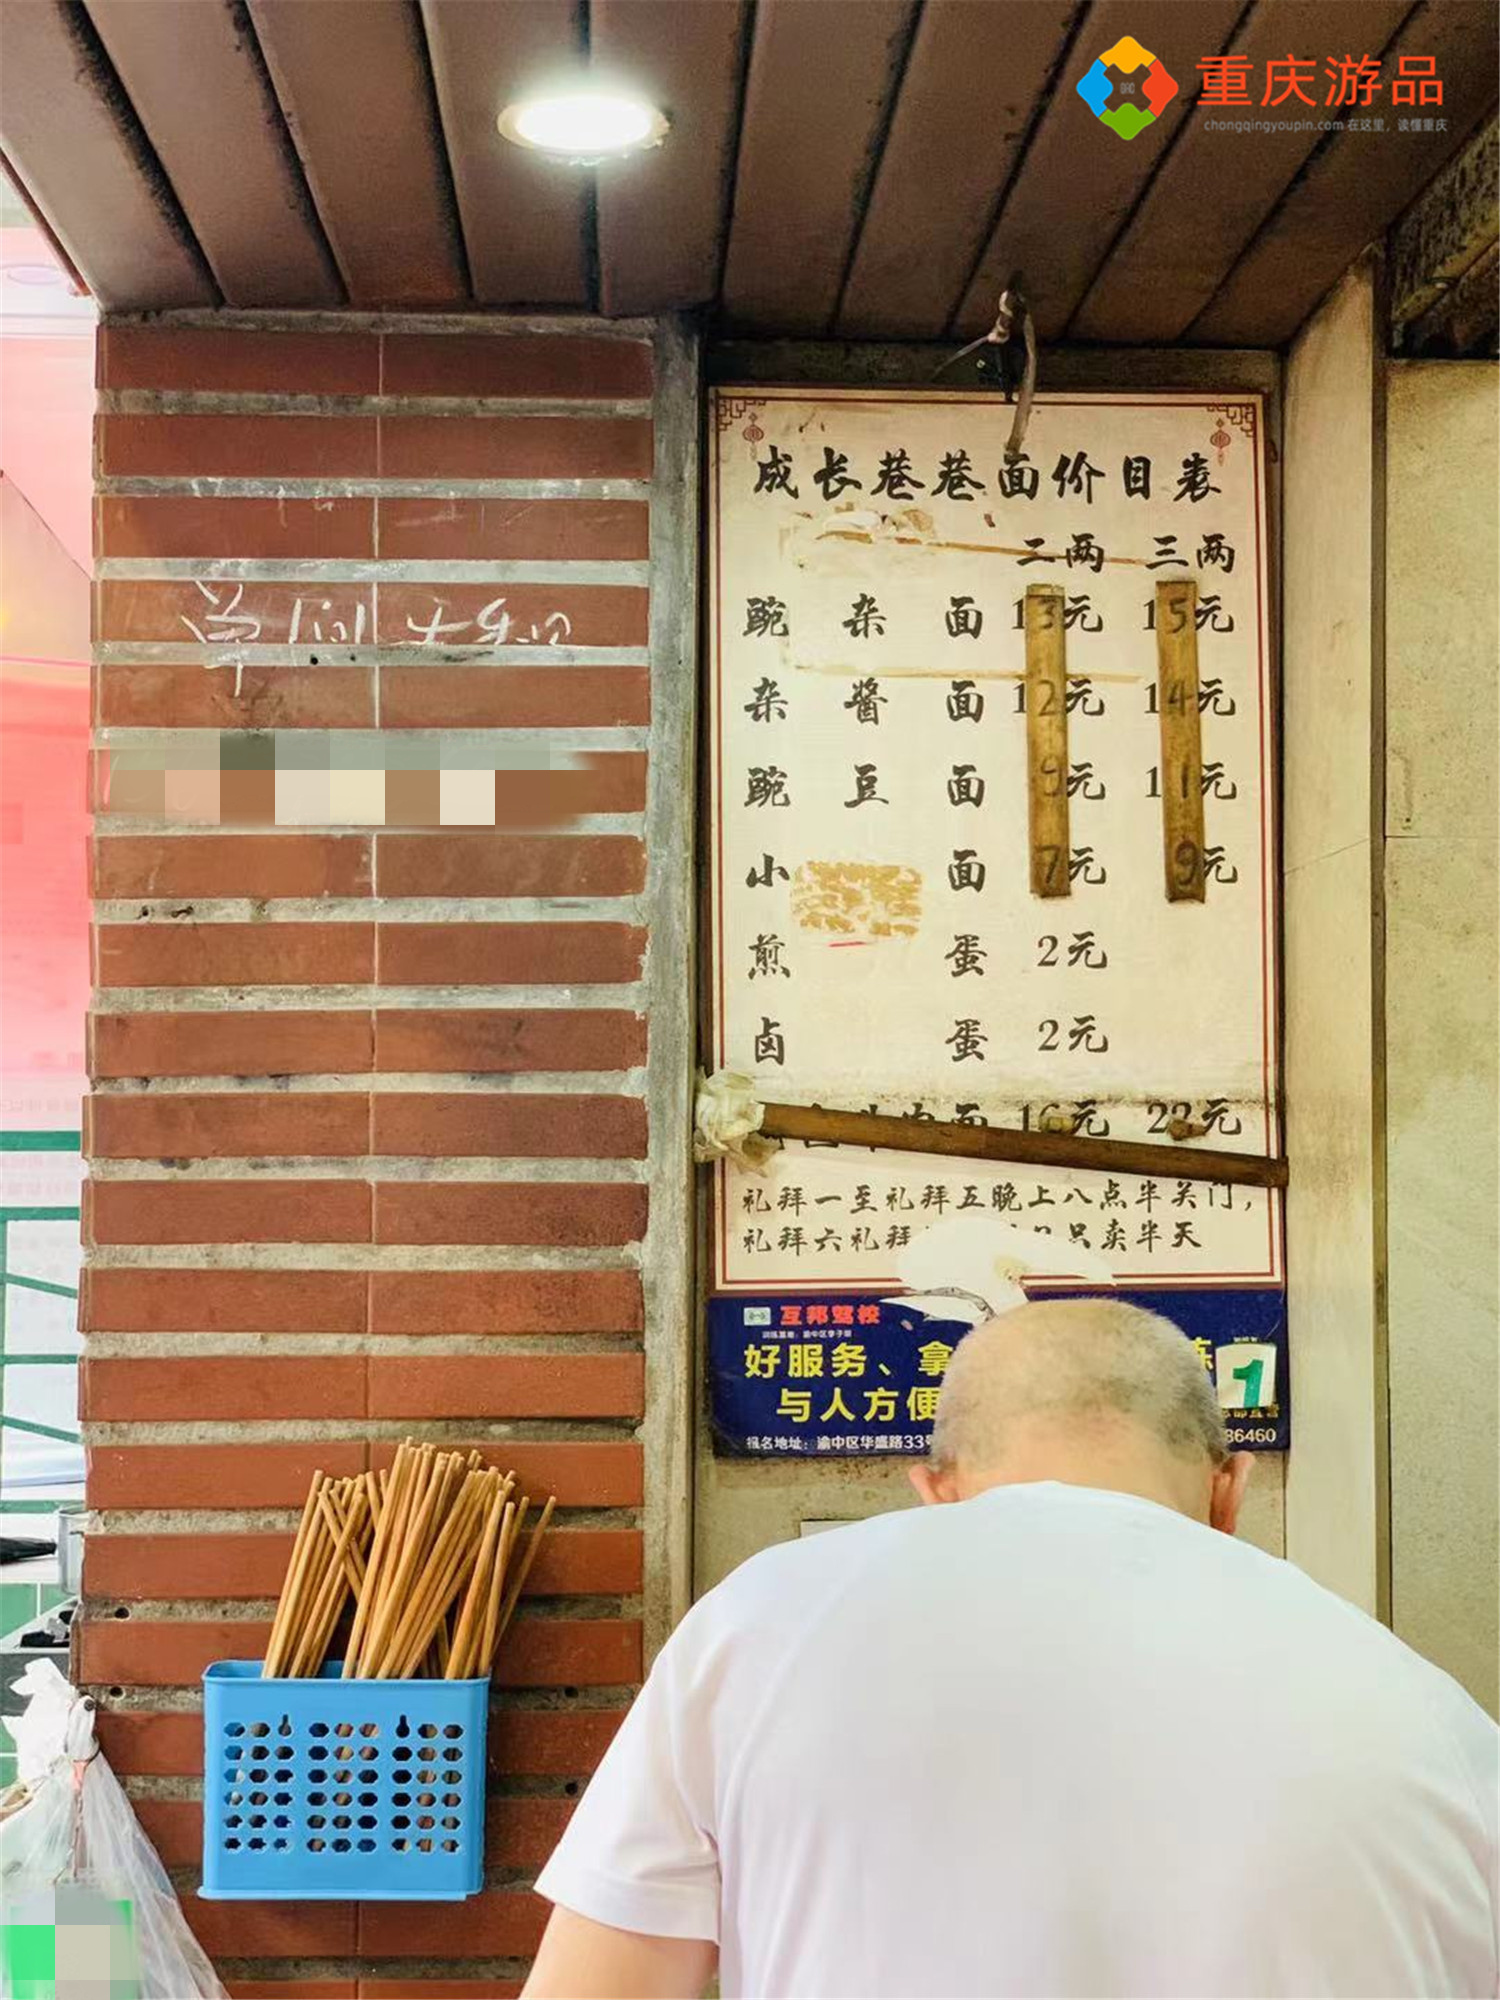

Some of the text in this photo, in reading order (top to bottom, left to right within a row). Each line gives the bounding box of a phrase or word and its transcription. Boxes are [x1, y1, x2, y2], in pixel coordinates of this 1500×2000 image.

[1016, 533, 1236, 573] 二两 三两
[1142, 594, 1235, 634] 15元
[1012, 678, 1105, 717] 12元
[1144, 678, 1236, 717] 14元
[1037, 845, 1107, 885] 7元
[1175, 837, 1238, 885] 9元
[1038, 931, 1107, 969] 2元
[1038, 1015, 1108, 1053] 2元
[1232, 1358, 1264, 1408] 1
